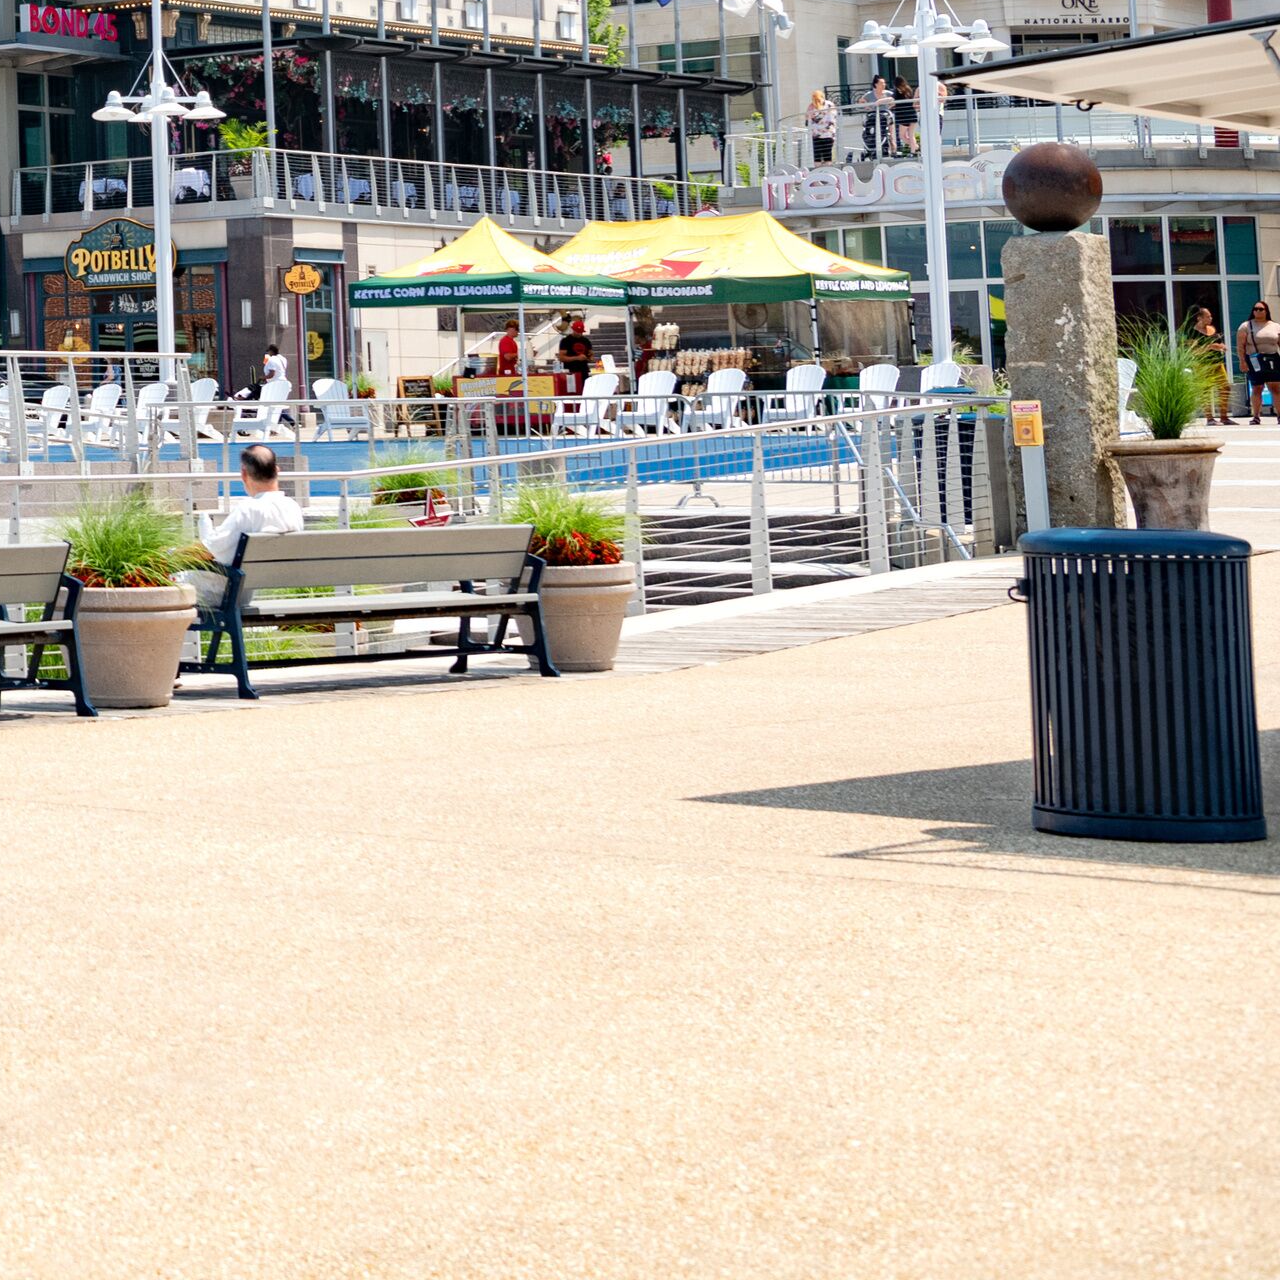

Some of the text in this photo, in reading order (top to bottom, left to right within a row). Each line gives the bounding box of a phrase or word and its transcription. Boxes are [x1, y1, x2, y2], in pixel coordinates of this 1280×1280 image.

[30, 4, 118, 41] BOND 45
[763, 164, 1003, 211] IT'SUGA
[71, 243, 157, 277] POTBELLY
[88, 271, 153, 284] SANDWICH SHOP
[354, 283, 513, 300] KETTLE CORN AND LEMONADE
[523, 284, 549, 296] KETTLE
[550, 285, 572, 296] CORN
[572, 286, 587, 296] AND
[651, 285, 714, 298] LEMONADE
[815, 280, 840, 291] KETTLE
[840, 280, 861, 292] CORN
[860, 280, 875, 291] AND
